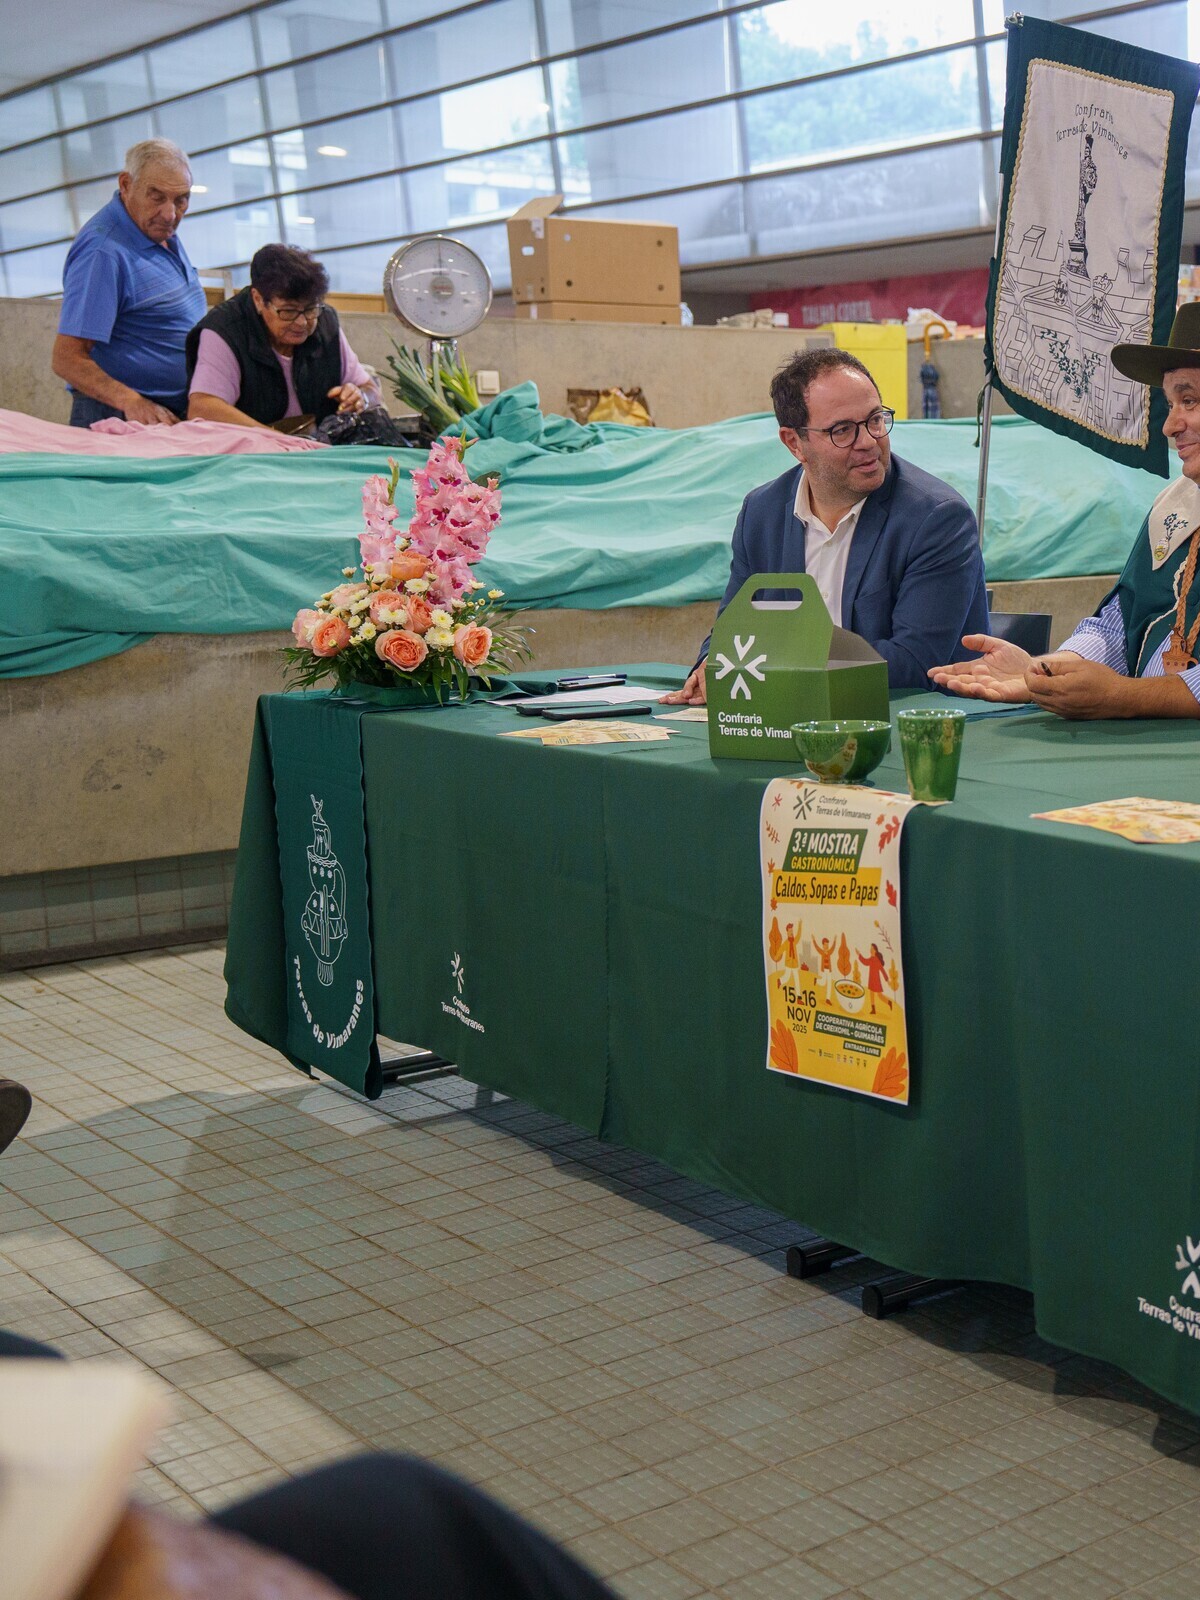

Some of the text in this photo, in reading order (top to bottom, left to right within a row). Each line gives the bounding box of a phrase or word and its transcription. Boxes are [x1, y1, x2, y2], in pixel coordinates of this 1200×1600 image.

[718, 711, 763, 725] Confraria
[718, 724, 749, 737] Terras
[750, 726, 763, 737] de
[815, 805, 872, 820] Terras de Vimaranes
[808, 832, 859, 855] MOSTRA
[791, 855, 856, 872] GASTRONÓMICA
[775, 875, 879, 907] Caldos, Sopas e Papas
[325, 979, 364, 1049] Vimaranes
[787, 1005, 812, 1024] NOV
[792, 1023, 808, 1034] 2025
[815, 1021, 823, 1030] DE
[823, 1023, 850, 1037] CREIXOMIL
[854, 1030, 885, 1044] GUIMARÃES
[817, 1014, 883, 1035] COOPERATIVA AGRÍCOLA
[844, 1042, 880, 1056] ENTRADA LIVRE
[1137, 1296, 1171, 1324] Terras
